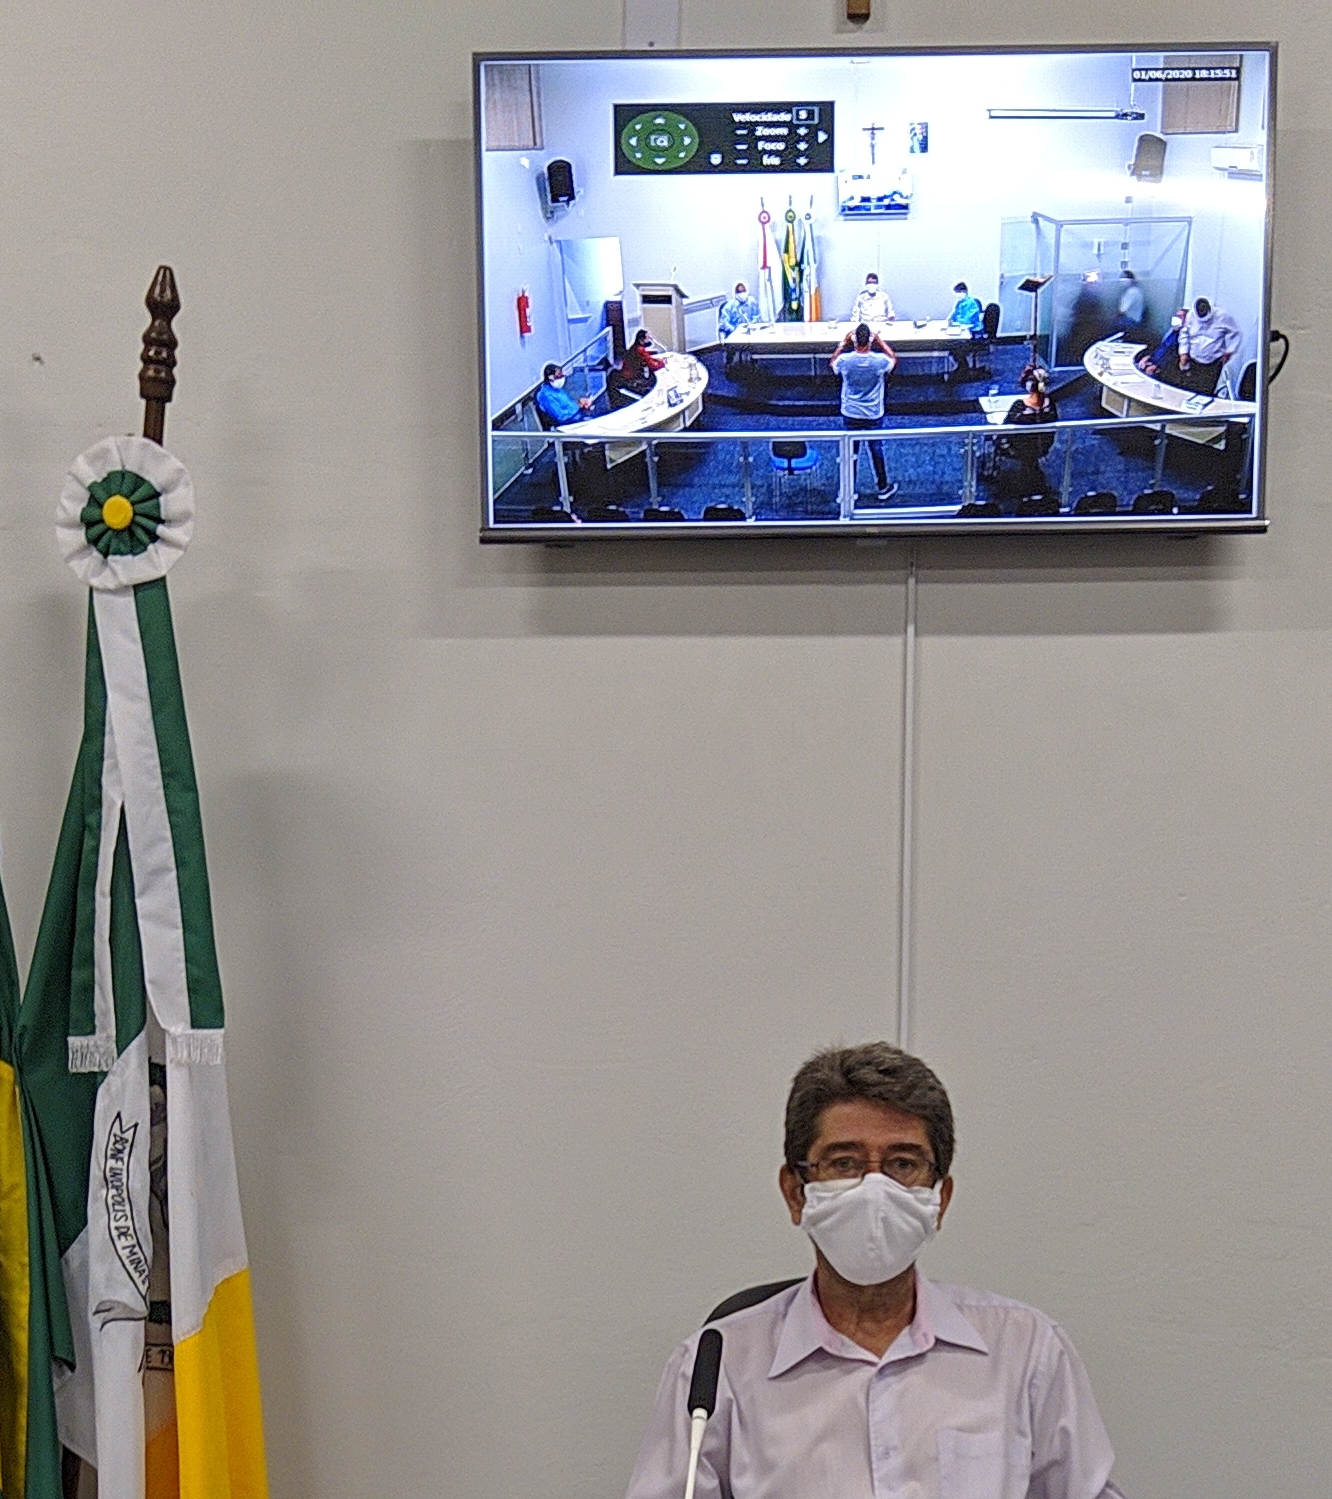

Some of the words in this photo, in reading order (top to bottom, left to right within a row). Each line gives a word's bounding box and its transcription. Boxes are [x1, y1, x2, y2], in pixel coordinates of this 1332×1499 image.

[1133, 69, 1193, 80] 01/06/2020
[754, 126, 789, 136] Zoom
[757, 140, 786, 151] Foco
